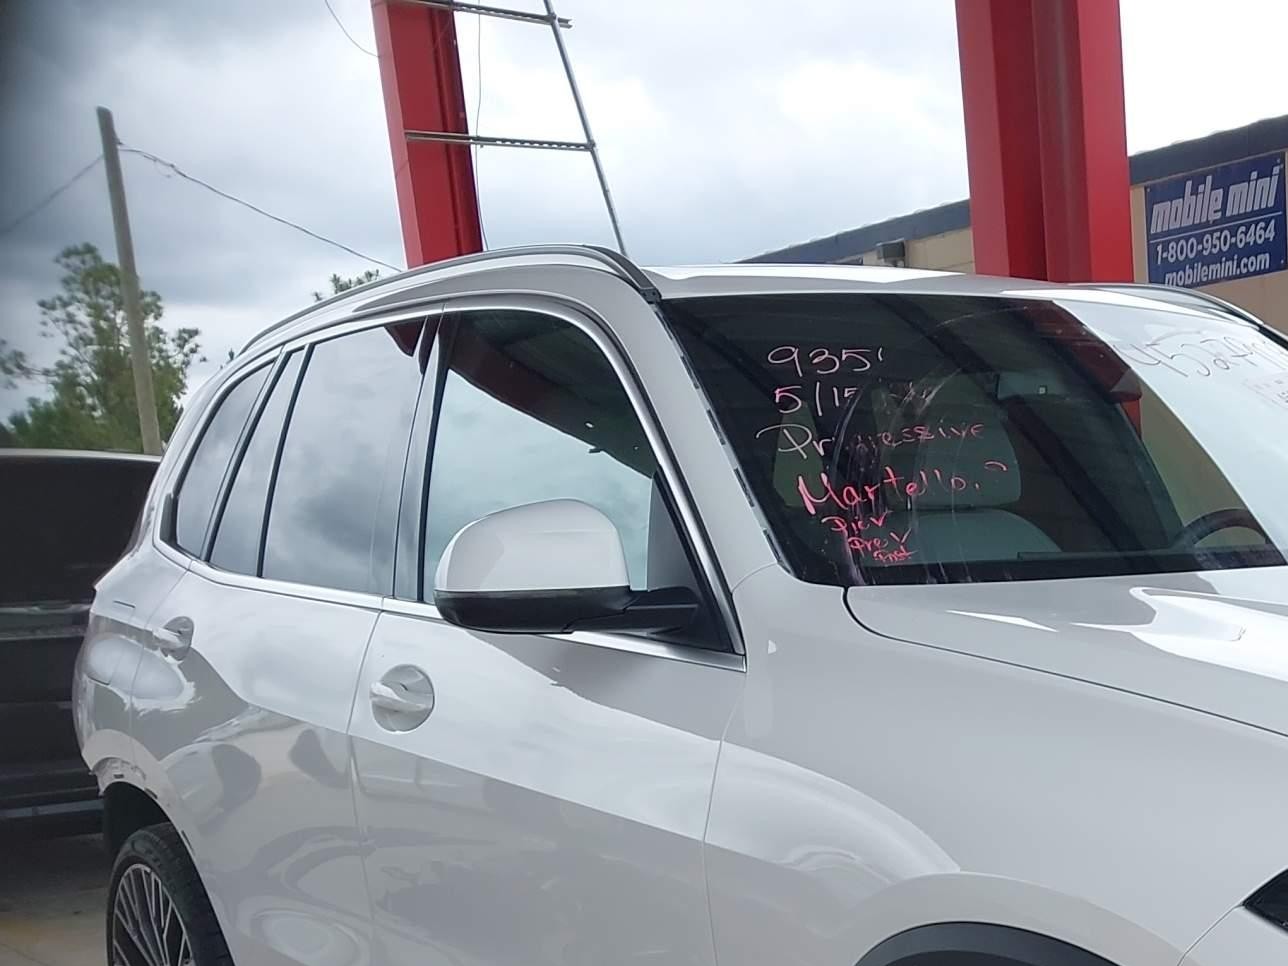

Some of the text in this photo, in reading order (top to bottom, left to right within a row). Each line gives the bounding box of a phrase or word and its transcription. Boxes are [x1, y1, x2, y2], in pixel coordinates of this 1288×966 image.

[1150, 165, 1281, 235] mobile mini
[1156, 219, 1276, 265] 1-800-950-6464
[1164, 252, 1270, 287] mobilemini.com
